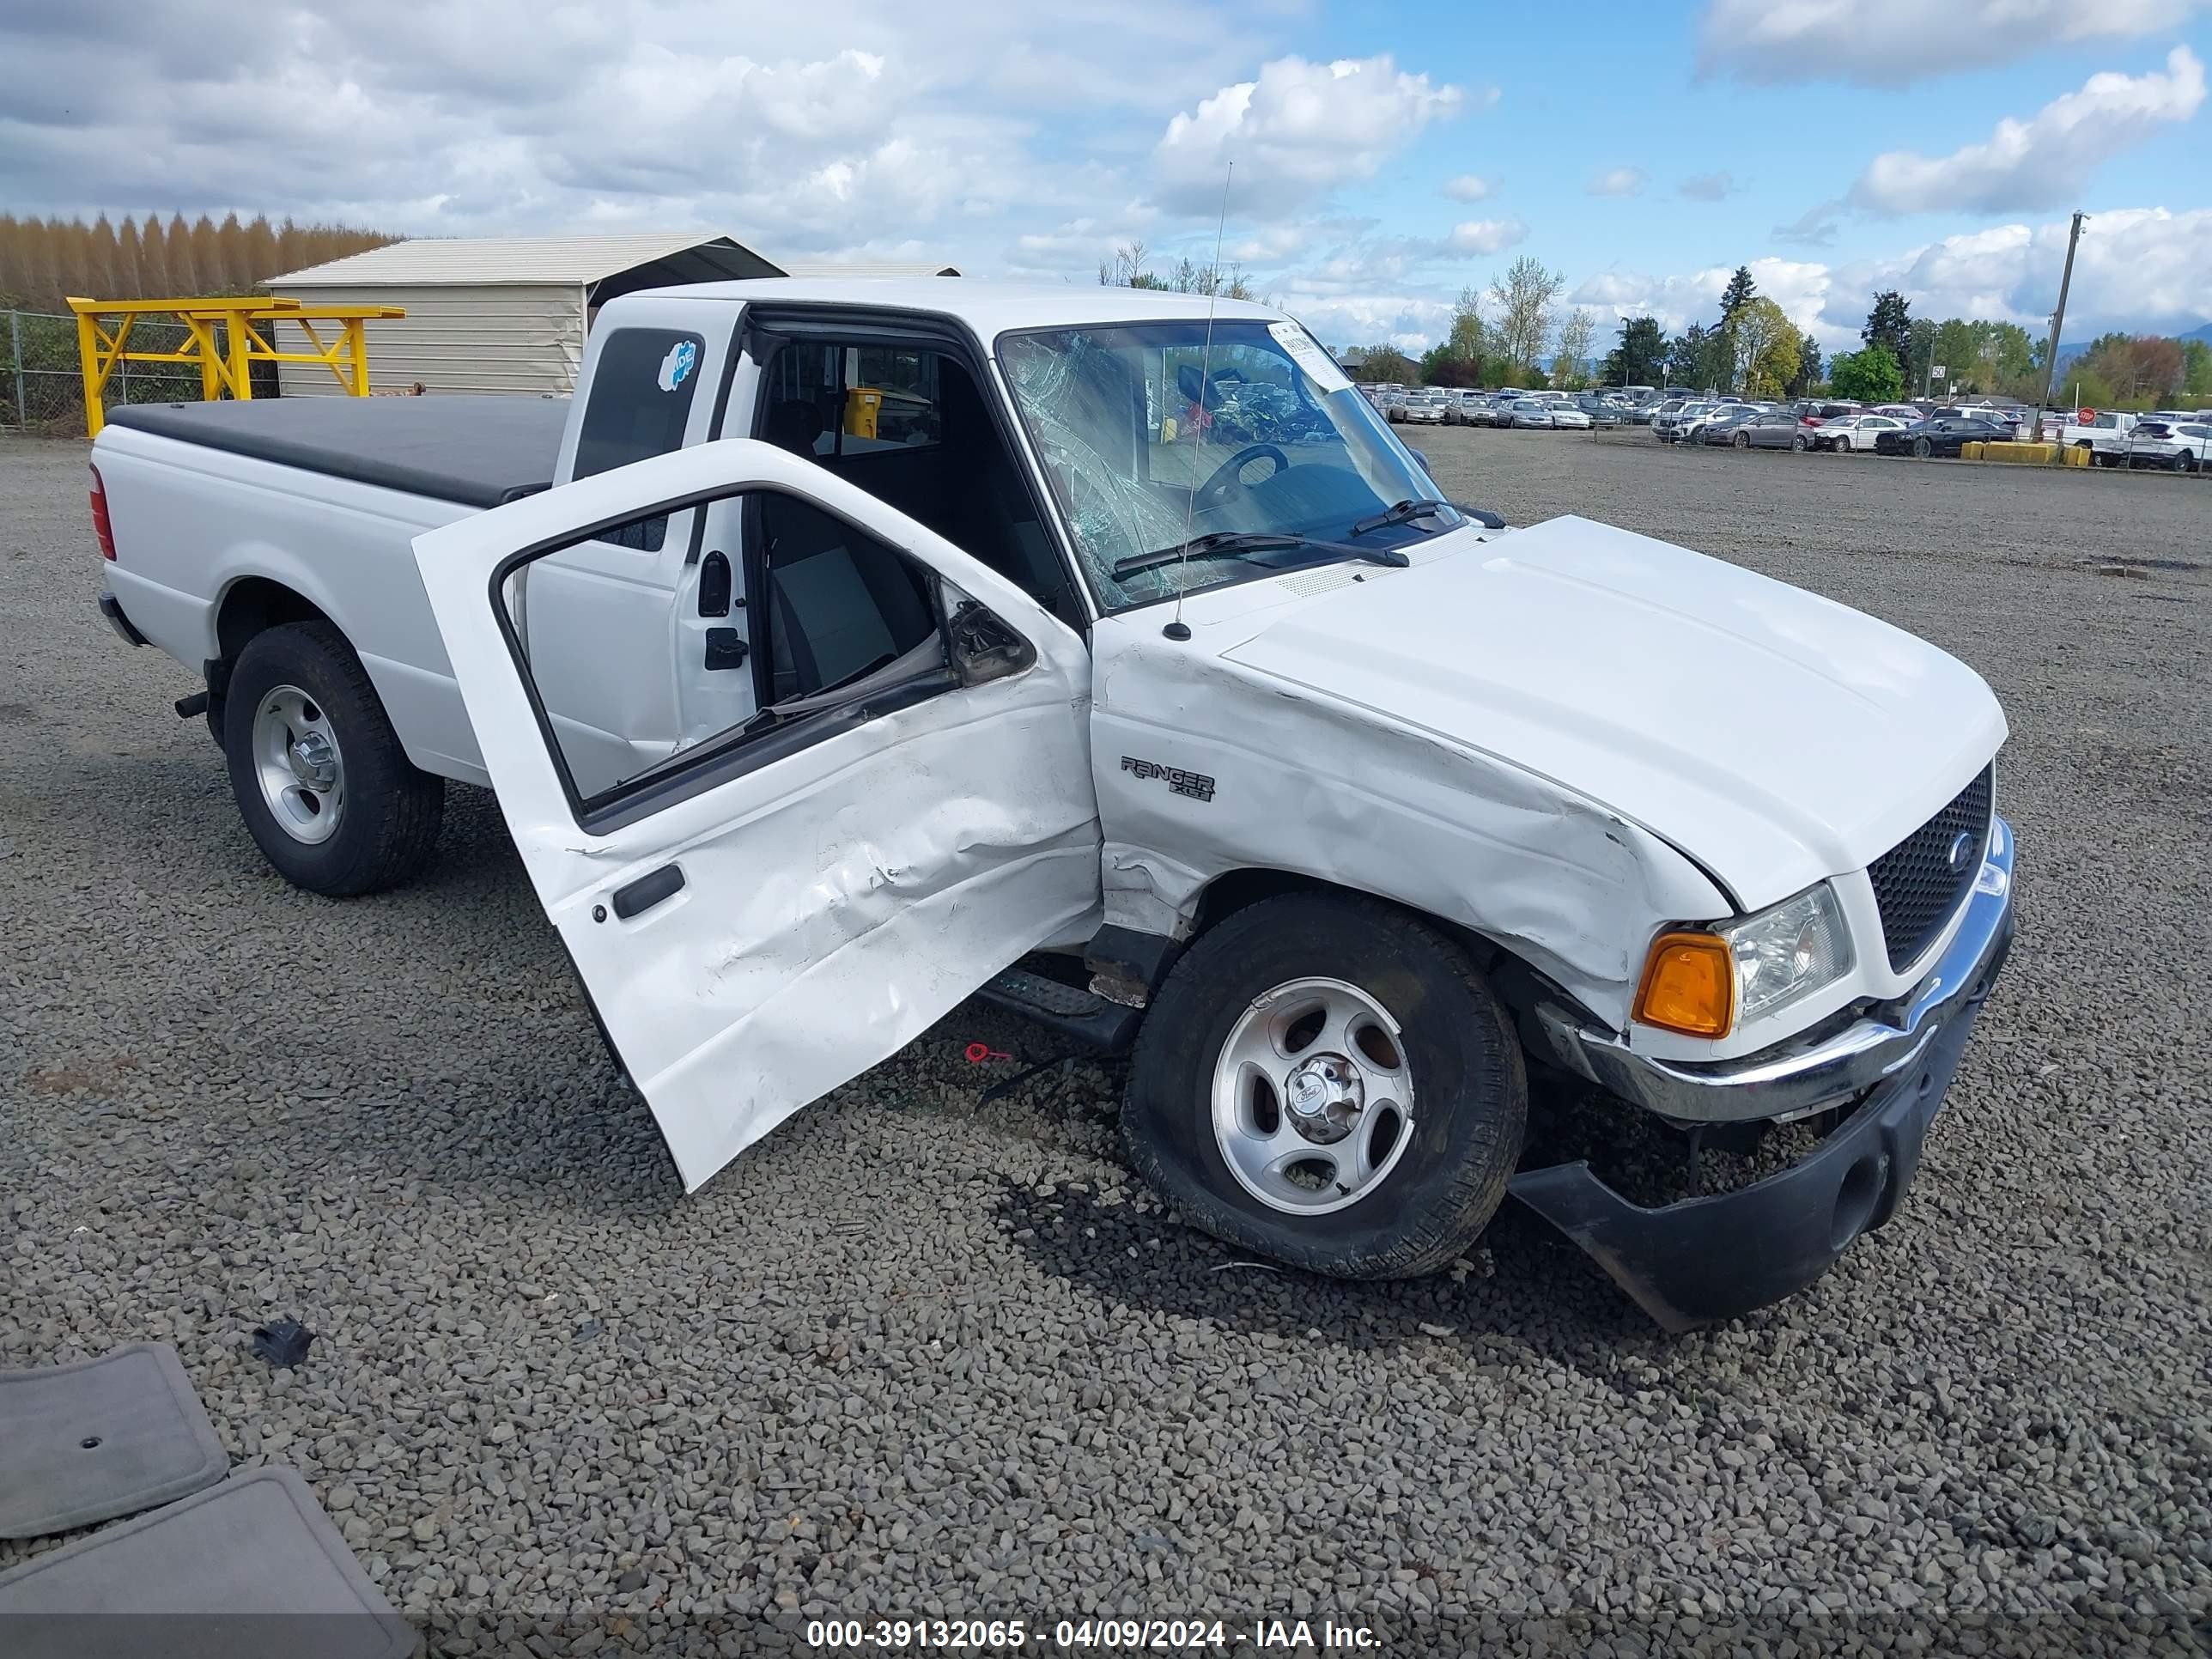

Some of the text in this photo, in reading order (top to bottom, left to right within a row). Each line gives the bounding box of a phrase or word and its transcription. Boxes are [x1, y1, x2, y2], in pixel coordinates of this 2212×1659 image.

[1934, 368, 1944, 377] 50
[2079, 411, 2094, 420] STOP
[1121, 756, 1215, 793] RANGER
[1300, 1090, 1316, 1100] Ford
